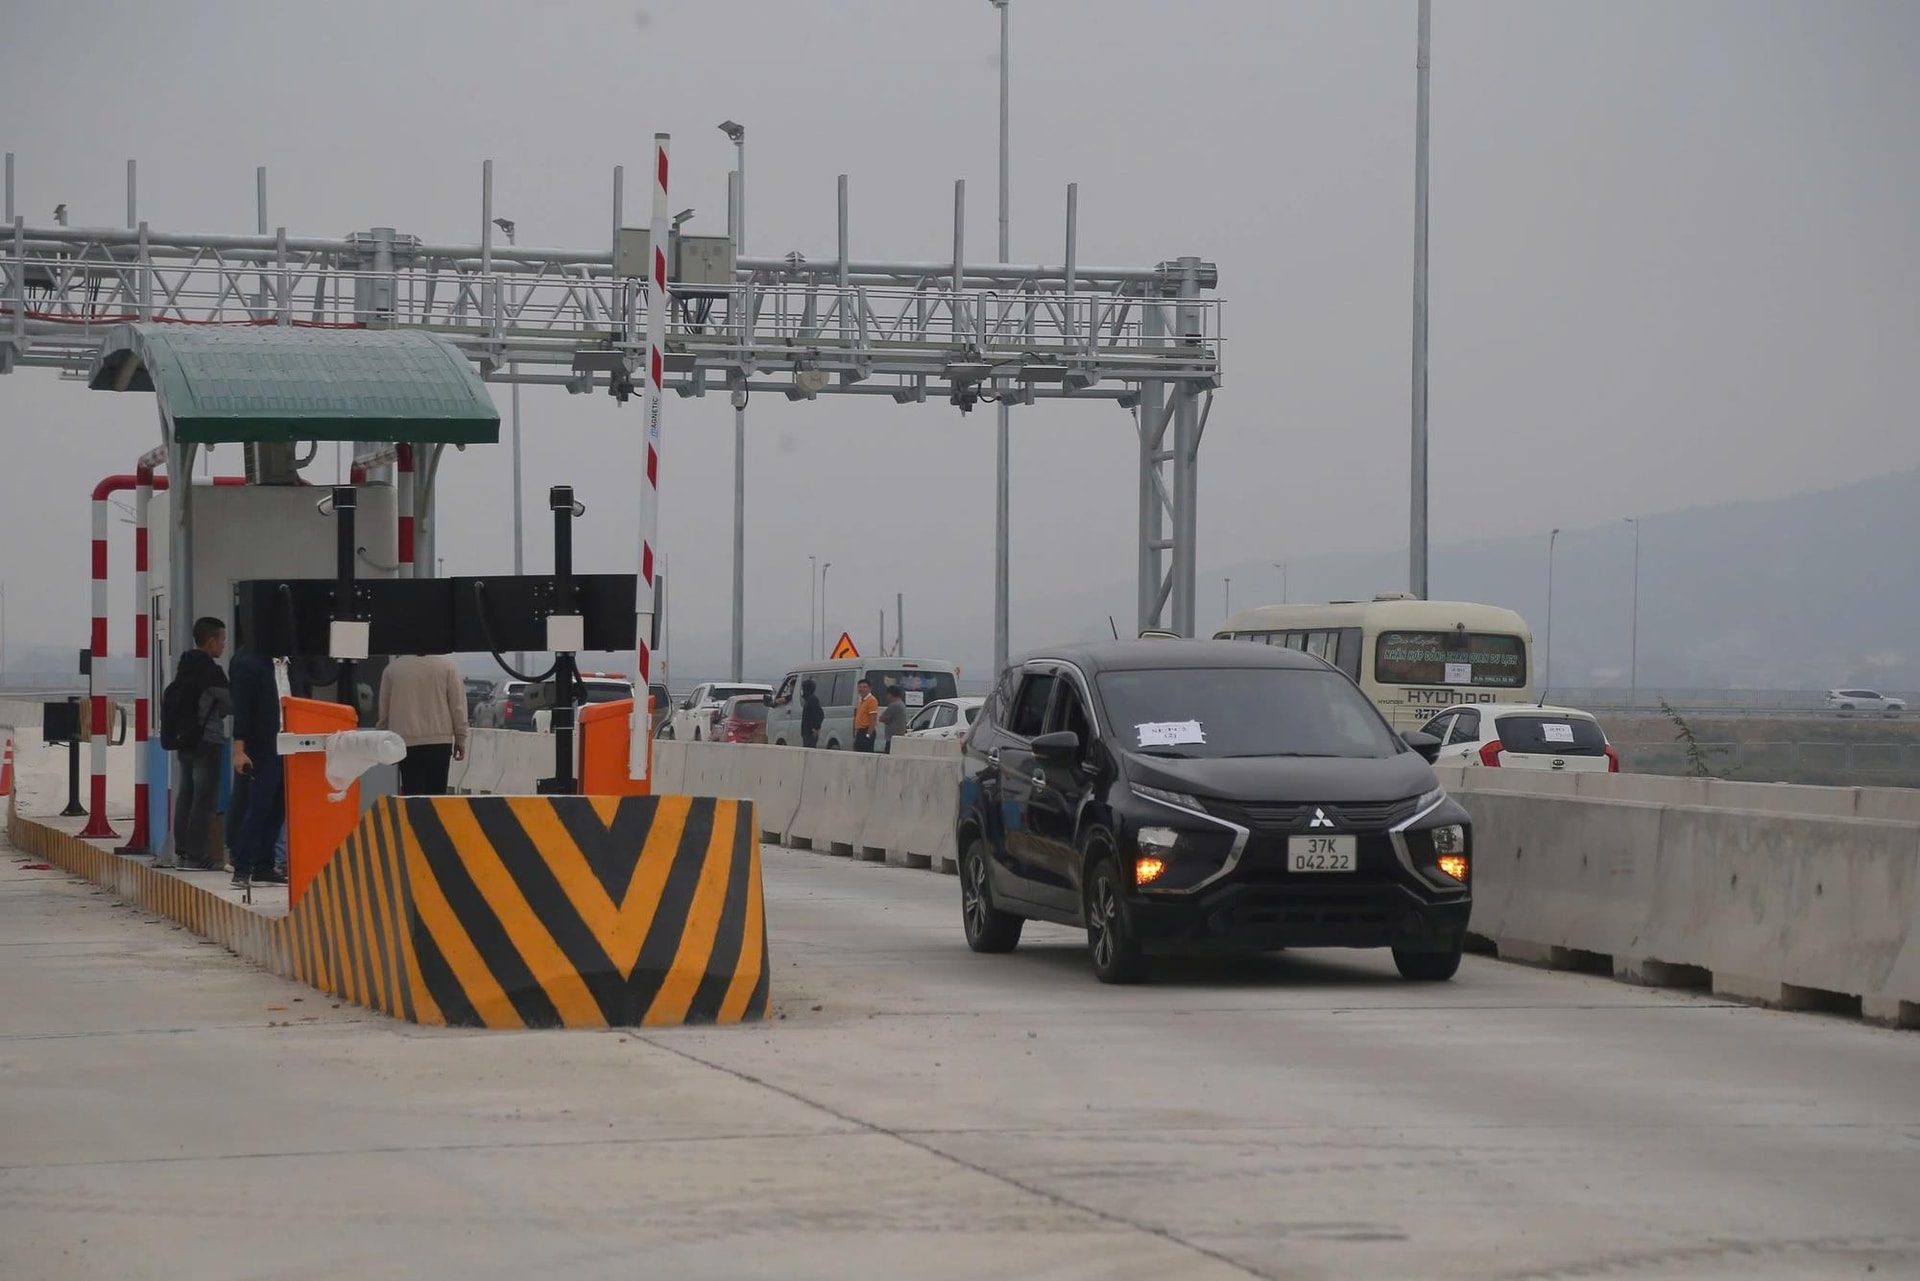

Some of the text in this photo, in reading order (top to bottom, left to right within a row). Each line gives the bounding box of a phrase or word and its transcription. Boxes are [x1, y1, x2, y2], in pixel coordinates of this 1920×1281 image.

[1384, 648, 1406, 662] NHẬN
[1308, 839, 1336, 853] 37K
[1296, 855, 1349, 870] 042.22
